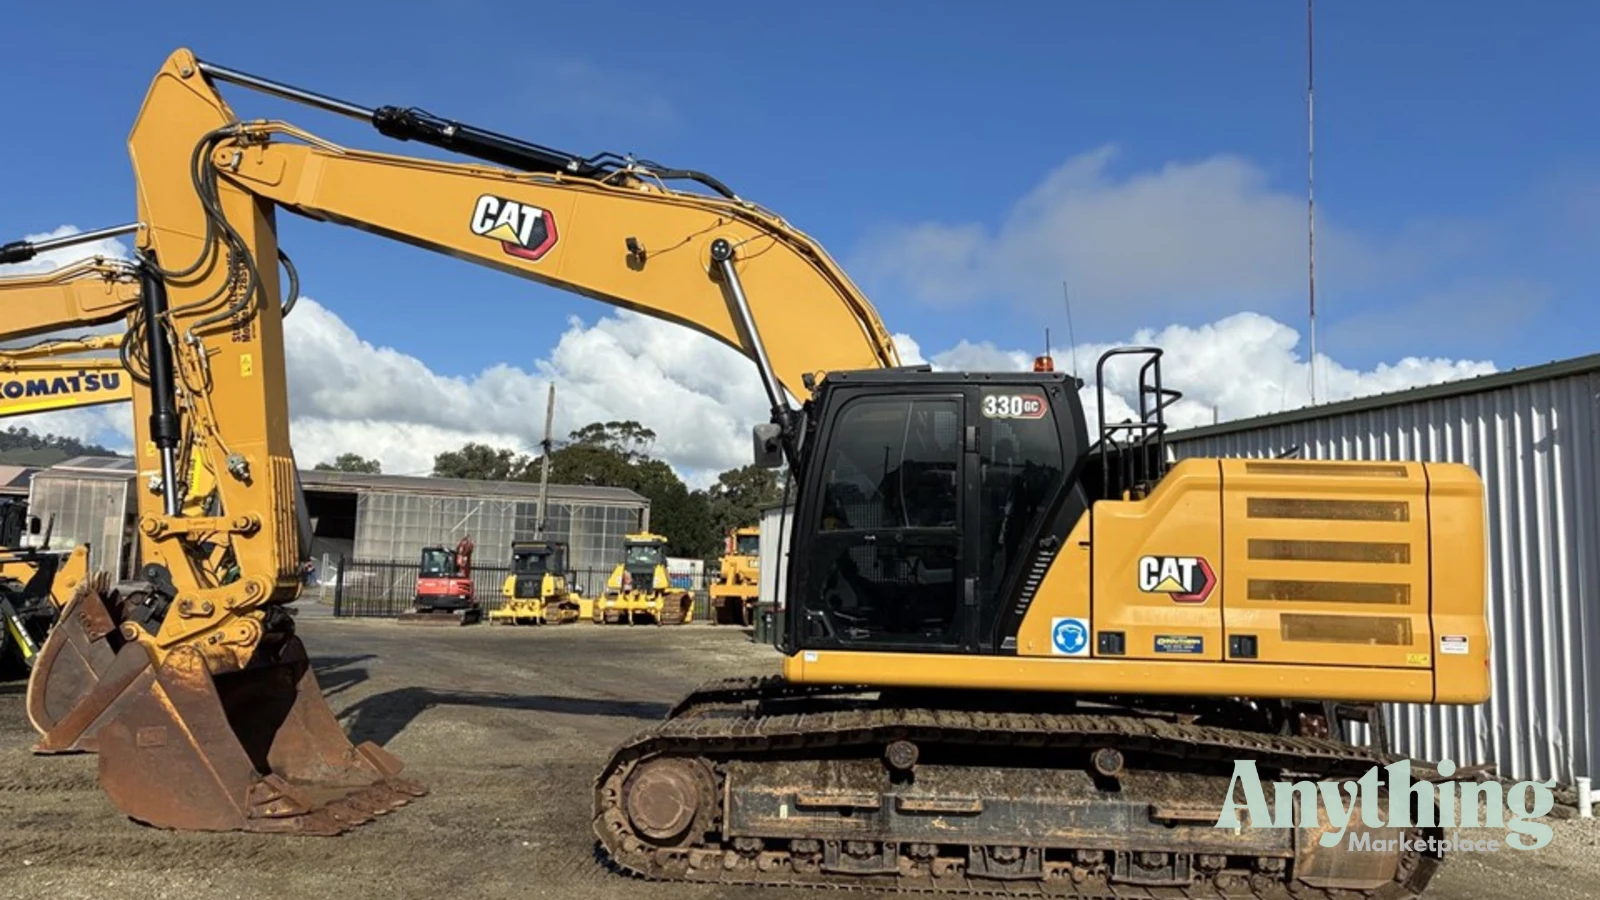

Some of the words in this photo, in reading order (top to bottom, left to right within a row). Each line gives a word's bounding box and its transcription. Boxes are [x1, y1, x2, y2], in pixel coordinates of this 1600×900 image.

[471, 195, 543, 247] CAT
[0, 370, 120, 399] OMATSU
[984, 395, 1023, 416] 330
[1140, 556, 1198, 593] CAT
